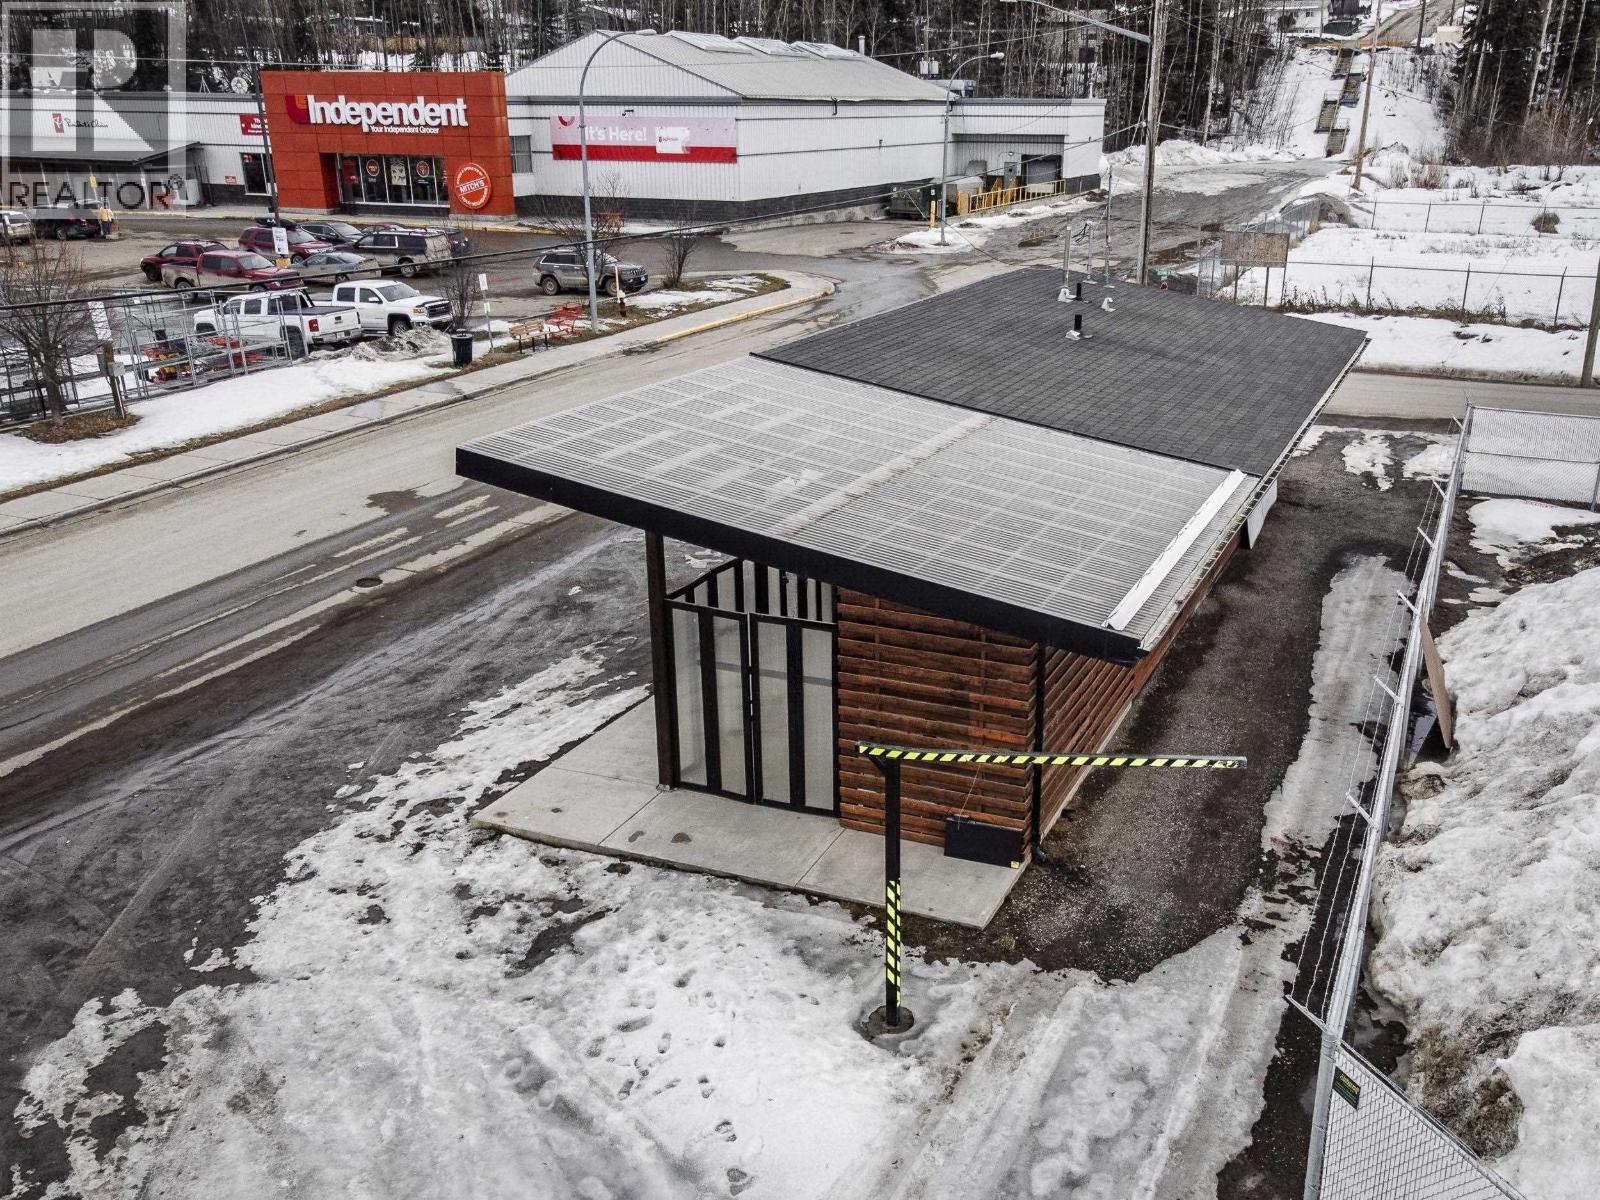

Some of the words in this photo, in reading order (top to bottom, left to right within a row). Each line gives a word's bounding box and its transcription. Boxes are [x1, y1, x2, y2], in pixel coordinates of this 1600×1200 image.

[306, 94, 469, 132] Independent
[370, 125, 384, 133] Your
[384, 126, 419, 134] Independent
[420, 126, 440, 134] Grocer
[585, 126, 606, 141] It's
[609, 126, 647, 141] Here!
[459, 179, 485, 193] MITCH'S
